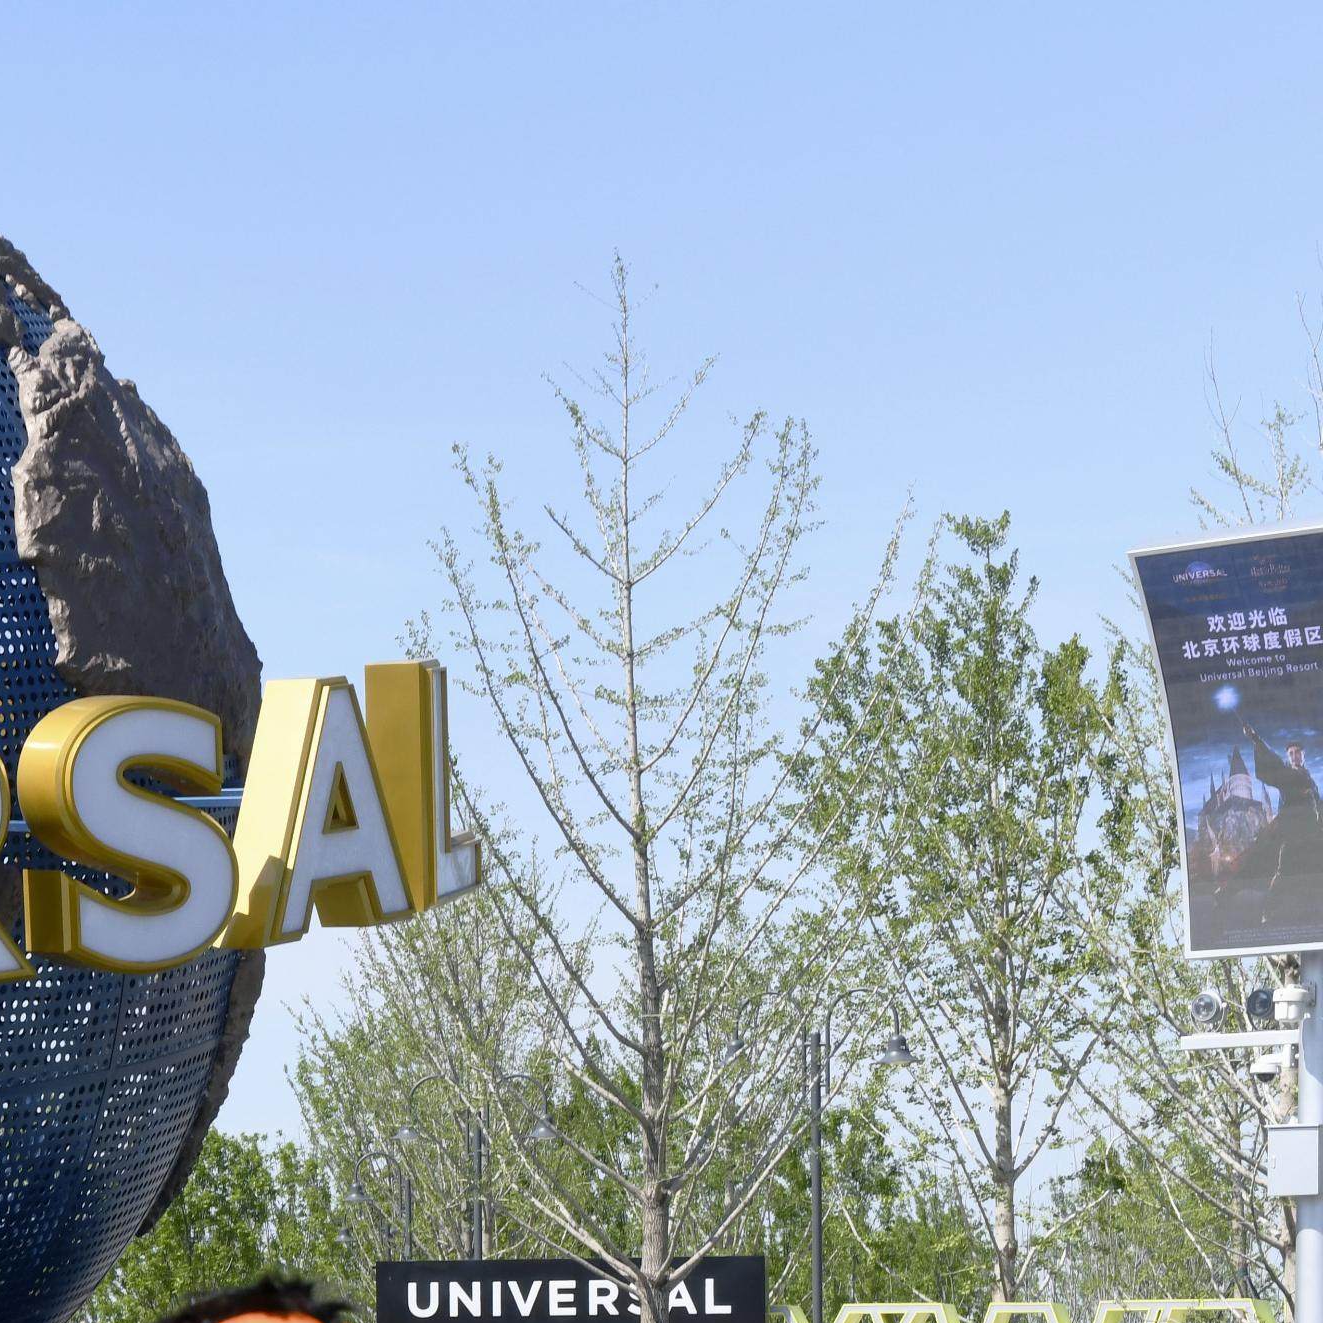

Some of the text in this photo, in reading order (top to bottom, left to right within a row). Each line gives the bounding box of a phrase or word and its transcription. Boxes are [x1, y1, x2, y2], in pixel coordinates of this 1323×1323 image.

[1172, 568, 1228, 584] UNIVERSAL
[1207, 607, 1288, 633] 欢迎光临
[1182, 626, 1323, 659] 北京环球度假区
[1225, 654, 1286, 667] Welcome to
[1200, 661, 1319, 682] Universal Beijing Resort
